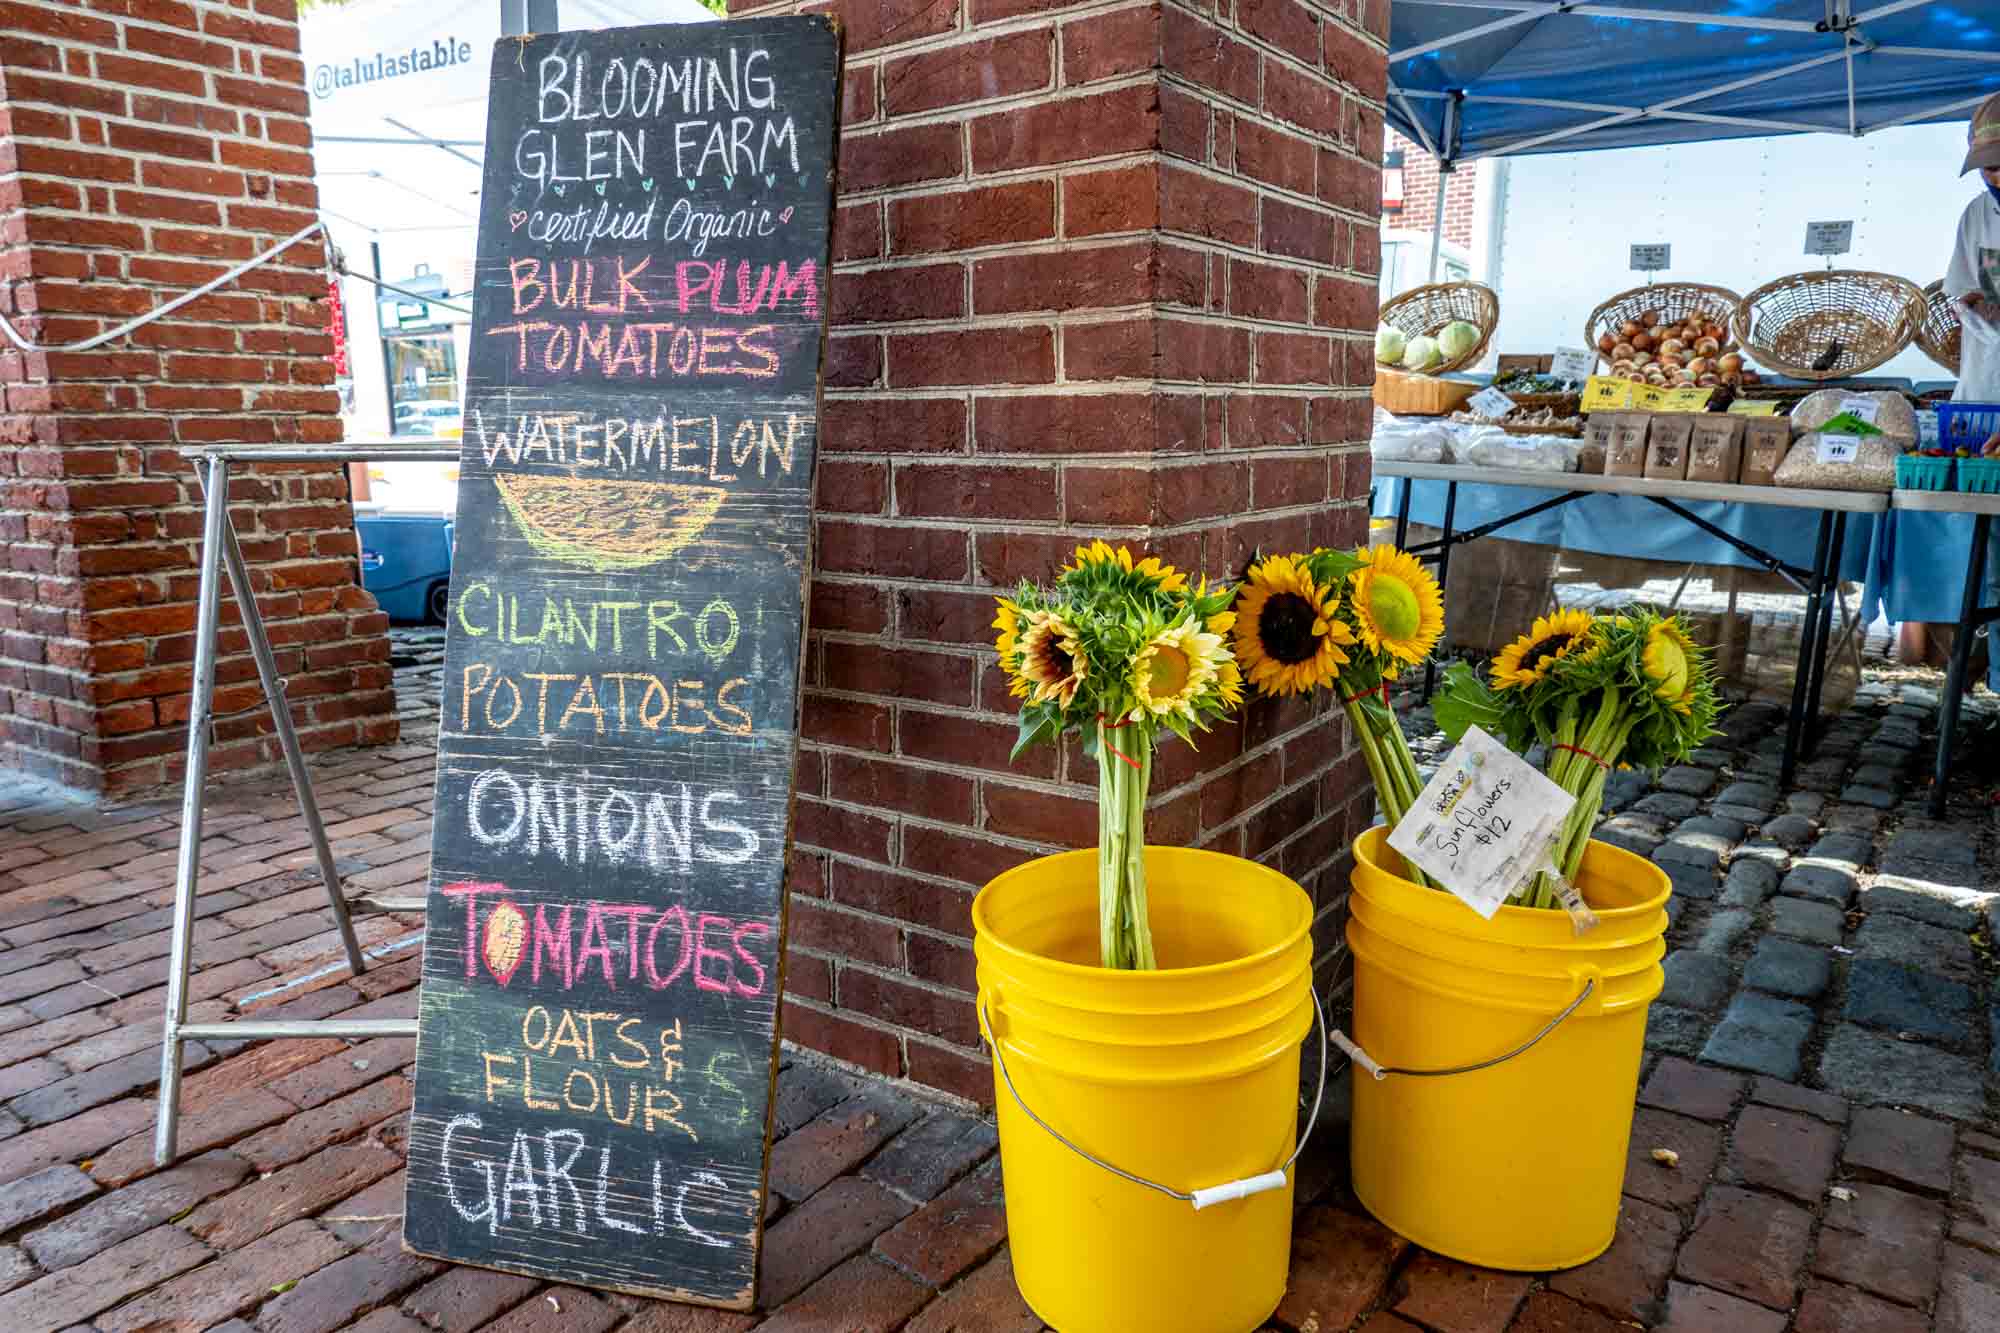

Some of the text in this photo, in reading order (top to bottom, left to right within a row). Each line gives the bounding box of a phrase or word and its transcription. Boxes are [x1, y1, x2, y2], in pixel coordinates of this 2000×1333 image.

[313, 36, 472, 99] @talulastable
[537, 47, 776, 122] BLOOMING
[514, 116, 800, 192] GLEN FARM
[663, 199, 776, 257] Organic
[510, 255, 818, 320] BULK PLUM
[488, 320, 780, 378] TOMATOES
[475, 408, 803, 482] WATERMELON
[456, 583, 741, 663] CILANTRO
[462, 662, 753, 737] POTATOES
[467, 768, 760, 874] ONIONS
[1435, 777, 1512, 857] Sunflowers
[1474, 815, 1512, 846] $12
[441, 880, 770, 997] TOMATOES
[522, 1005, 651, 1069] OATS
[481, 1051, 699, 1144] FLOUR
[441, 1112, 735, 1248] GARLIC
